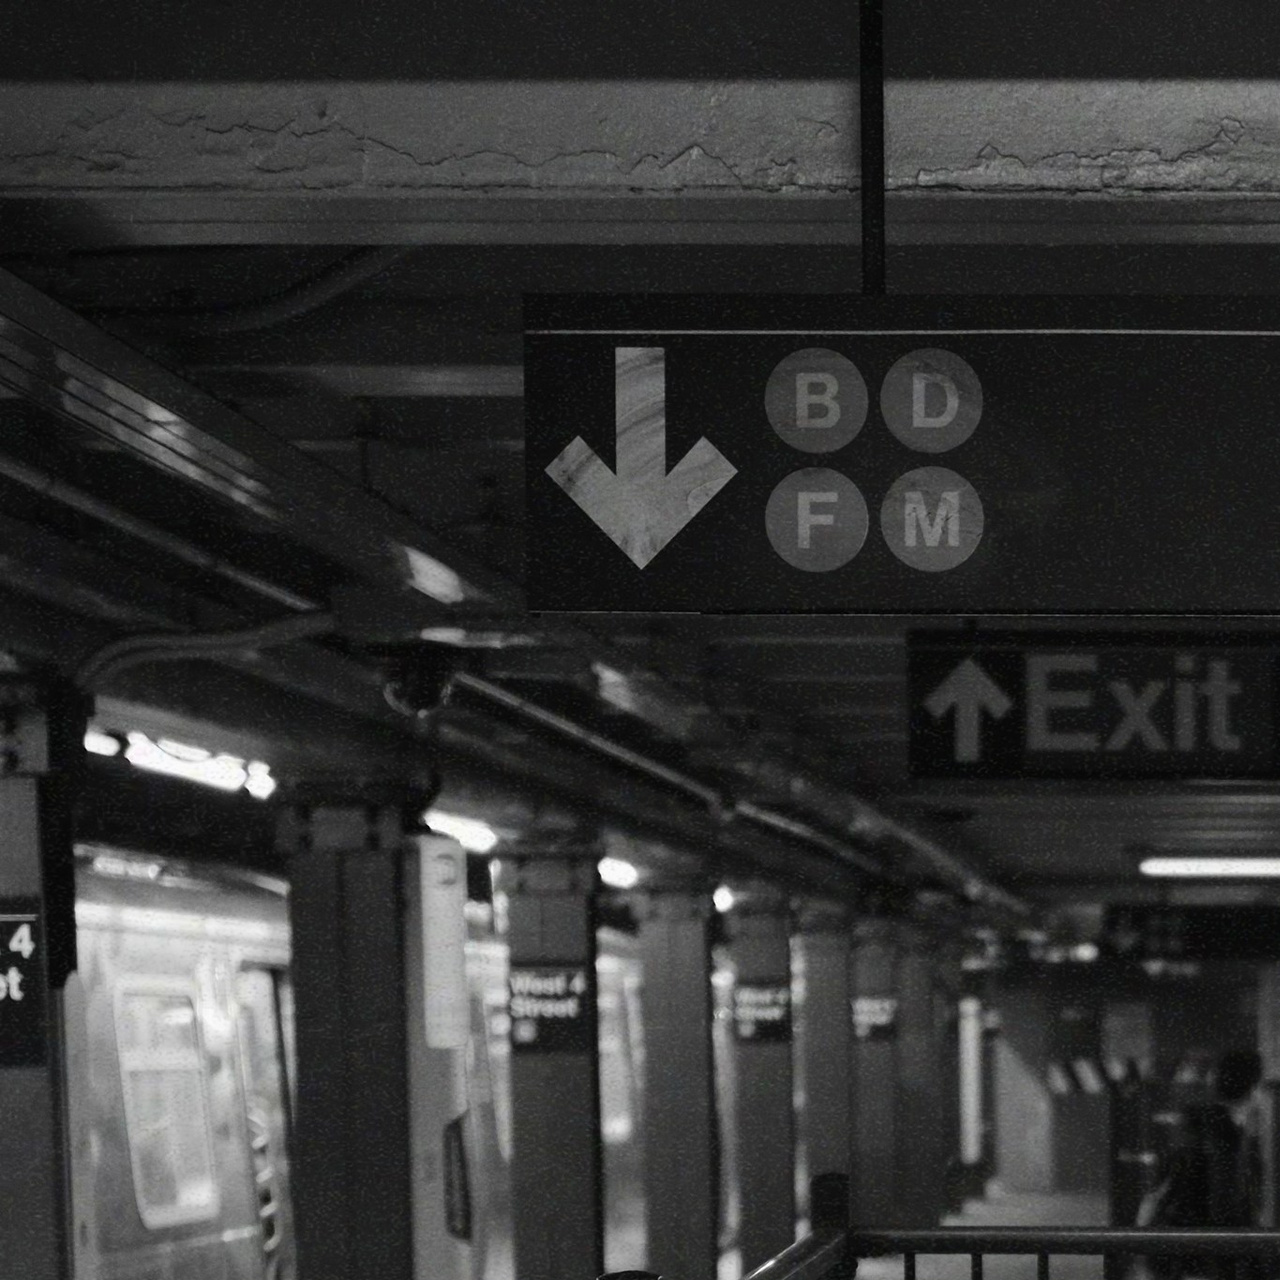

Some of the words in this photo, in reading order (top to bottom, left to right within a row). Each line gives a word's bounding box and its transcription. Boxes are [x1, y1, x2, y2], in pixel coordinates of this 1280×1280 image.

[795, 372, 840, 428] B
[912, 372, 959, 428] D
[797, 491, 838, 549] F
[904, 490, 960, 547] M
[1025, 653, 1242, 751] Exit
[9, 923, 35, 959] 4
[510, 971, 567, 995] West
